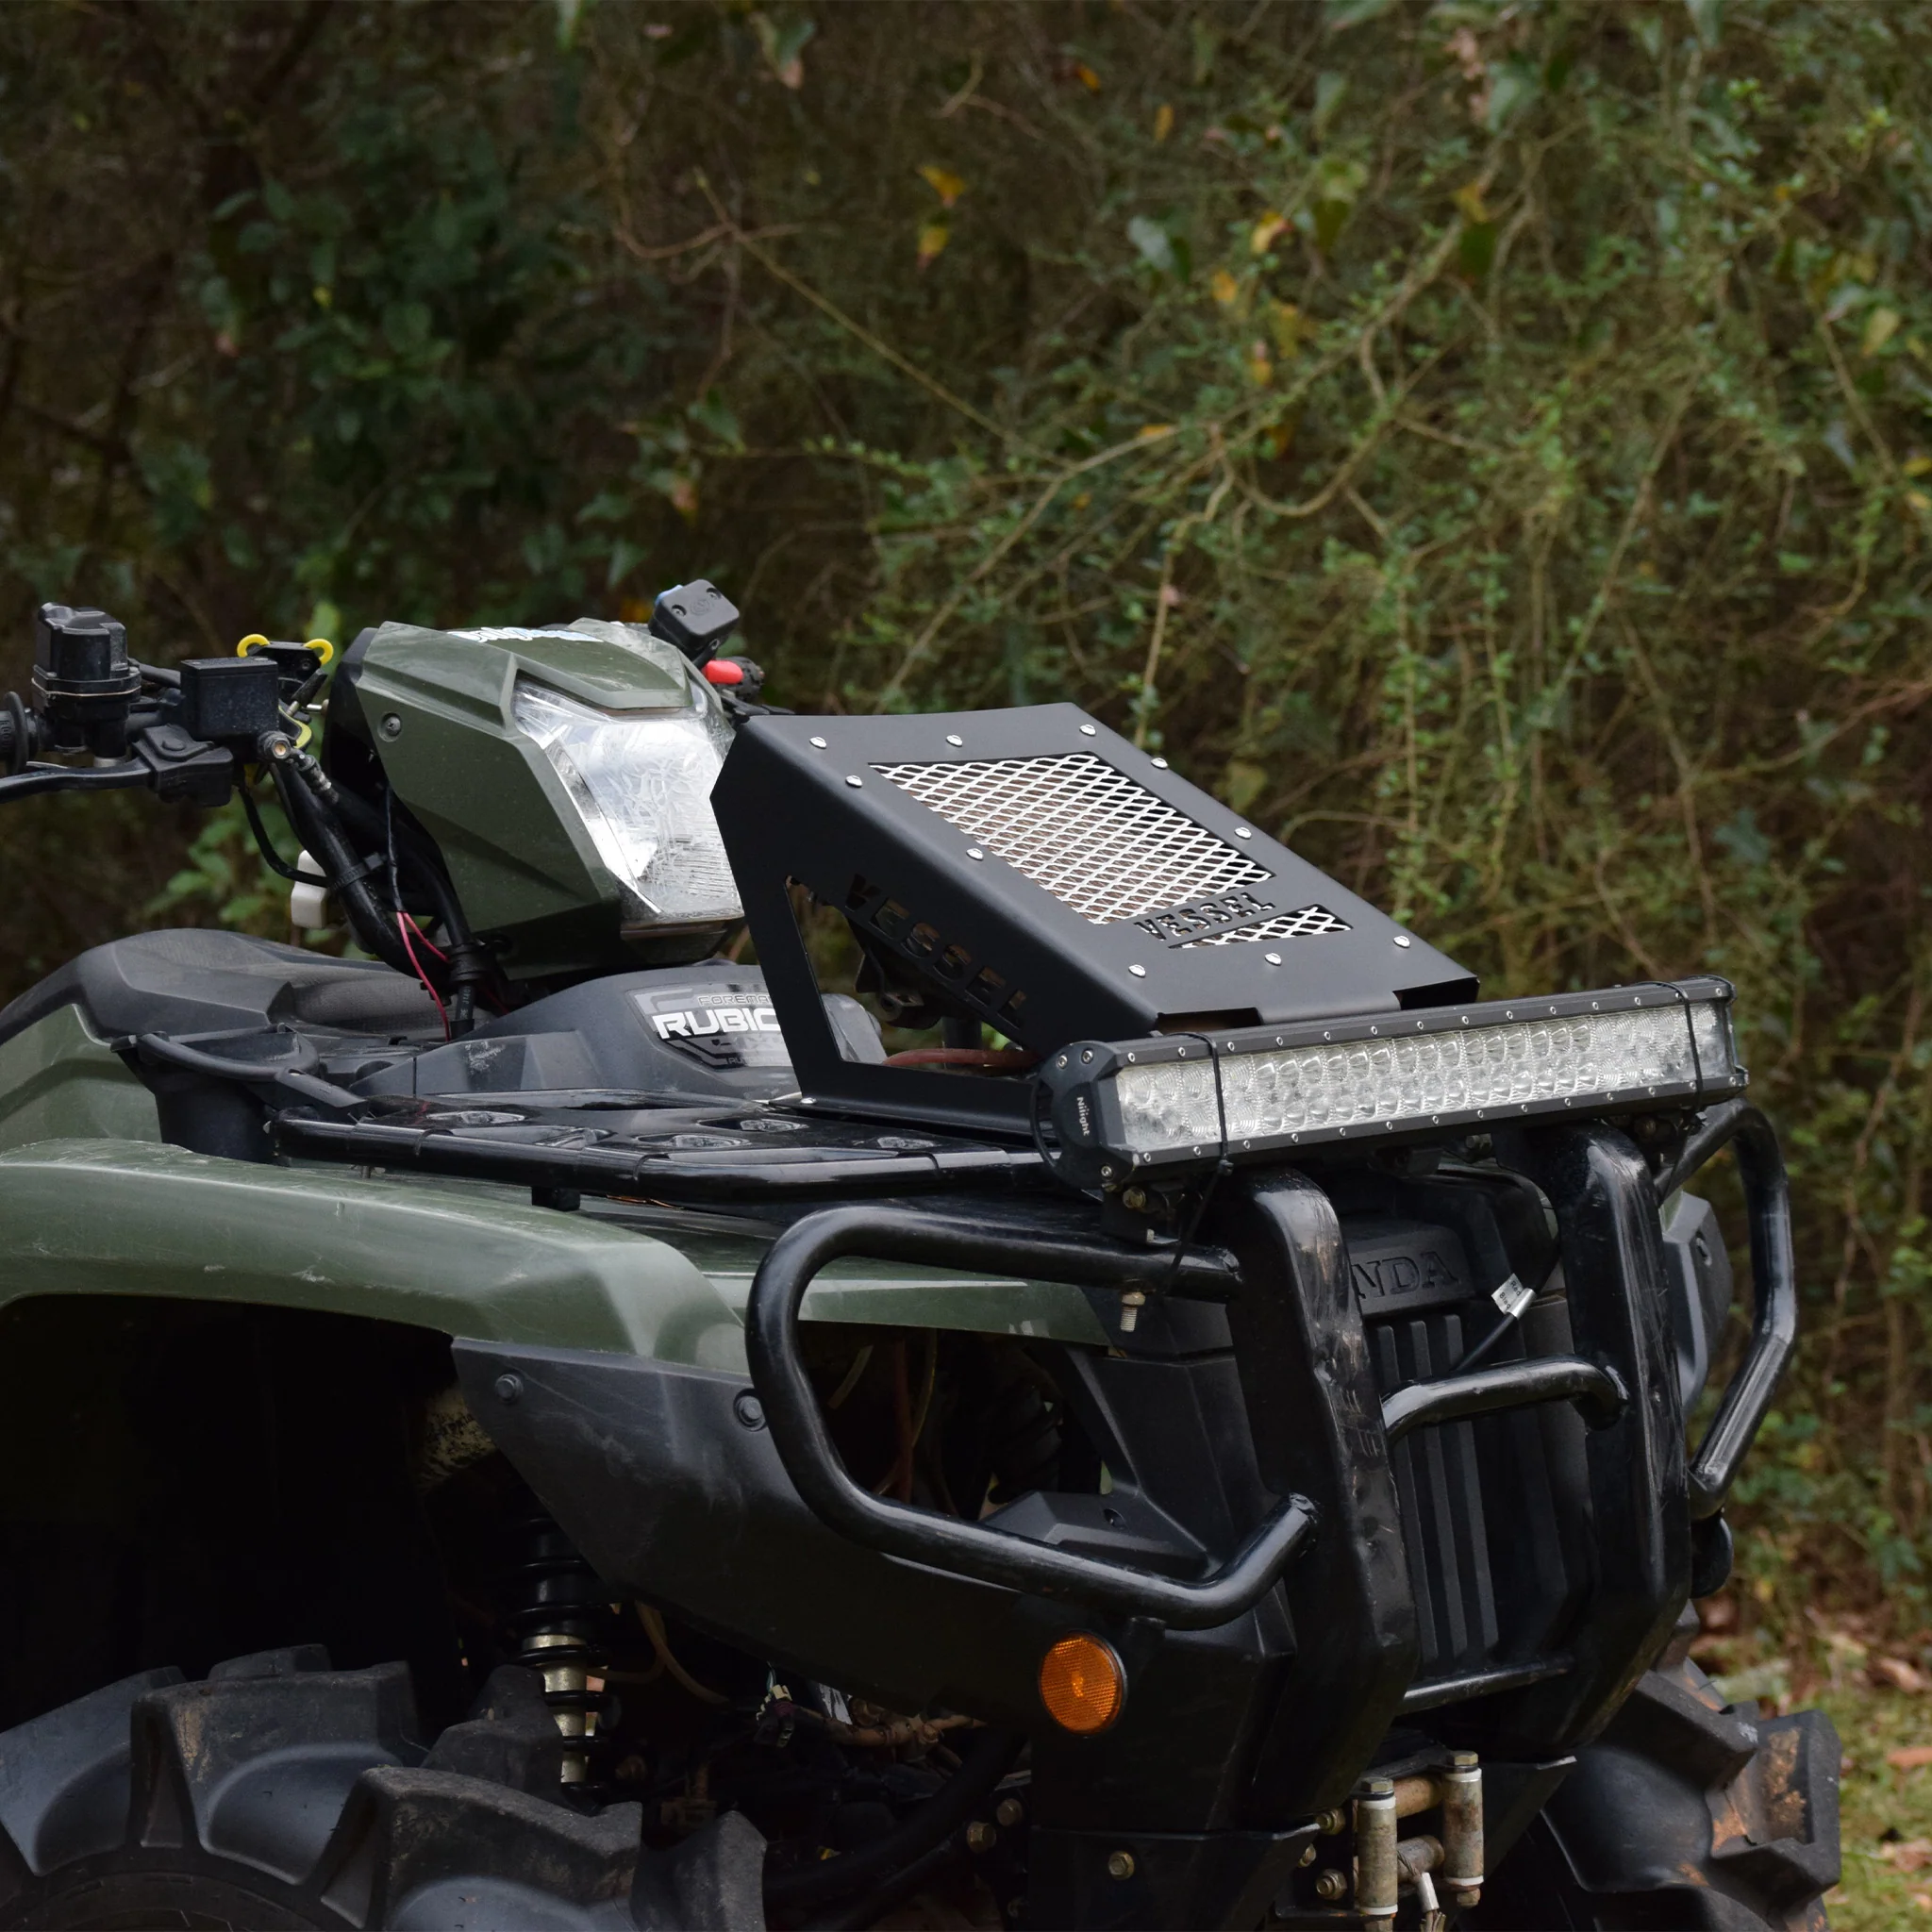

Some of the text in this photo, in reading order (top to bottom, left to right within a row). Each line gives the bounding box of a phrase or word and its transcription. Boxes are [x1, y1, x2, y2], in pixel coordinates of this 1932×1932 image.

[1134, 891, 1275, 941] VESSEL
[845, 874, 1026, 1030] VESSEL
[652, 1008, 781, 1040] RUBIC
[1076, 1096, 1091, 1137] Nilight
[1351, 1251, 1459, 1299] NDA
